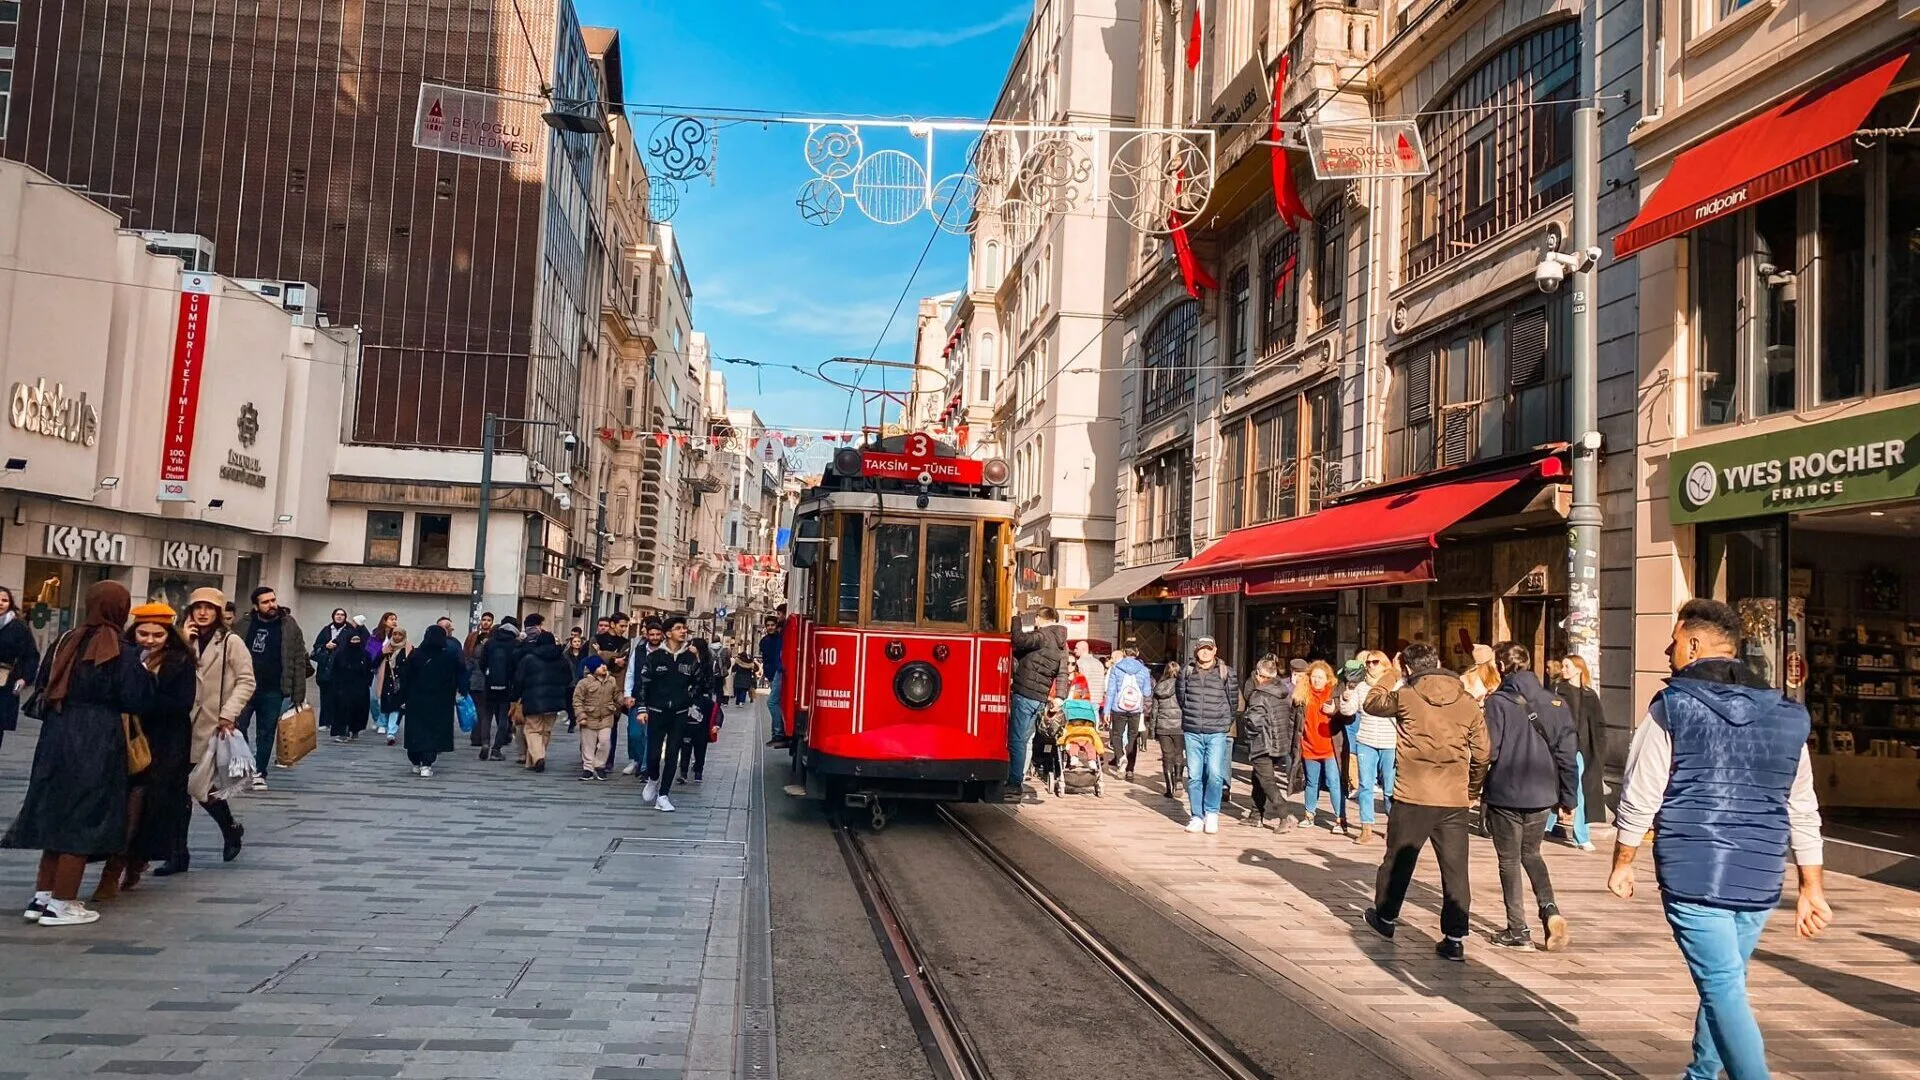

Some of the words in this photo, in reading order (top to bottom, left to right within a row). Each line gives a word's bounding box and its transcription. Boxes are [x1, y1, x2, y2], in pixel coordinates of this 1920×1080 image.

[1695, 189, 1748, 220] midpoint
[911, 435, 927, 457] 3
[864, 459, 909, 472] TAKSİM
[923, 462, 962, 476] TÜNEL
[1723, 460, 1782, 490] YVES
[1789, 439, 1906, 481] ROCHER
[1772, 480, 1844, 501] FRANCE
[819, 648, 837, 666] 410
